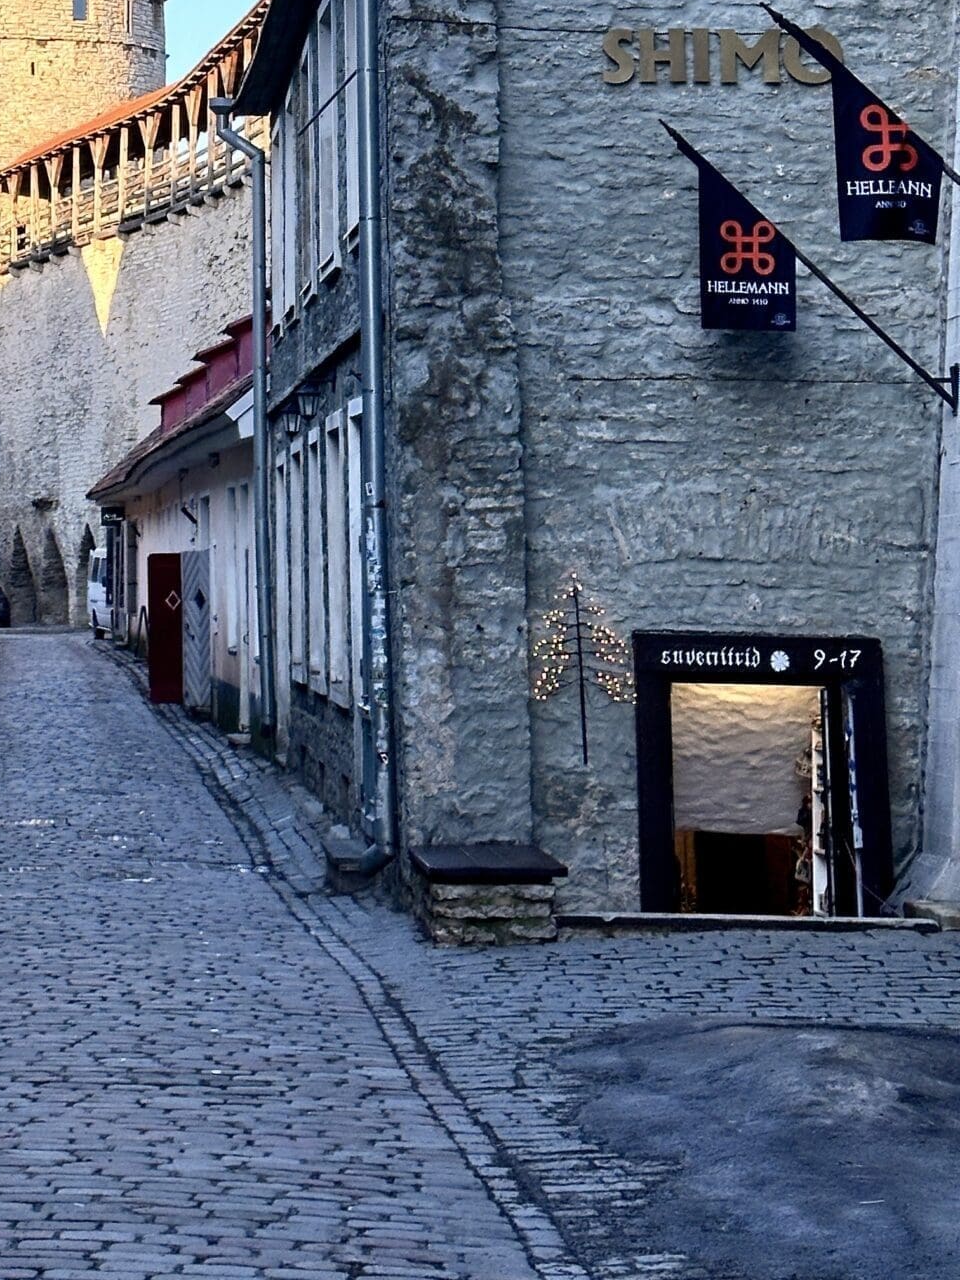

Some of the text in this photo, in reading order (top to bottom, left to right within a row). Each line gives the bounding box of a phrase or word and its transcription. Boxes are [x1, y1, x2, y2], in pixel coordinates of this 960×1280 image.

[602, 28, 844, 85] SHIMO
[846, 180, 932, 198] HELLEANN
[707, 280, 789, 295] HELLEMANN
[814, 649, 862, 670] 9-17
